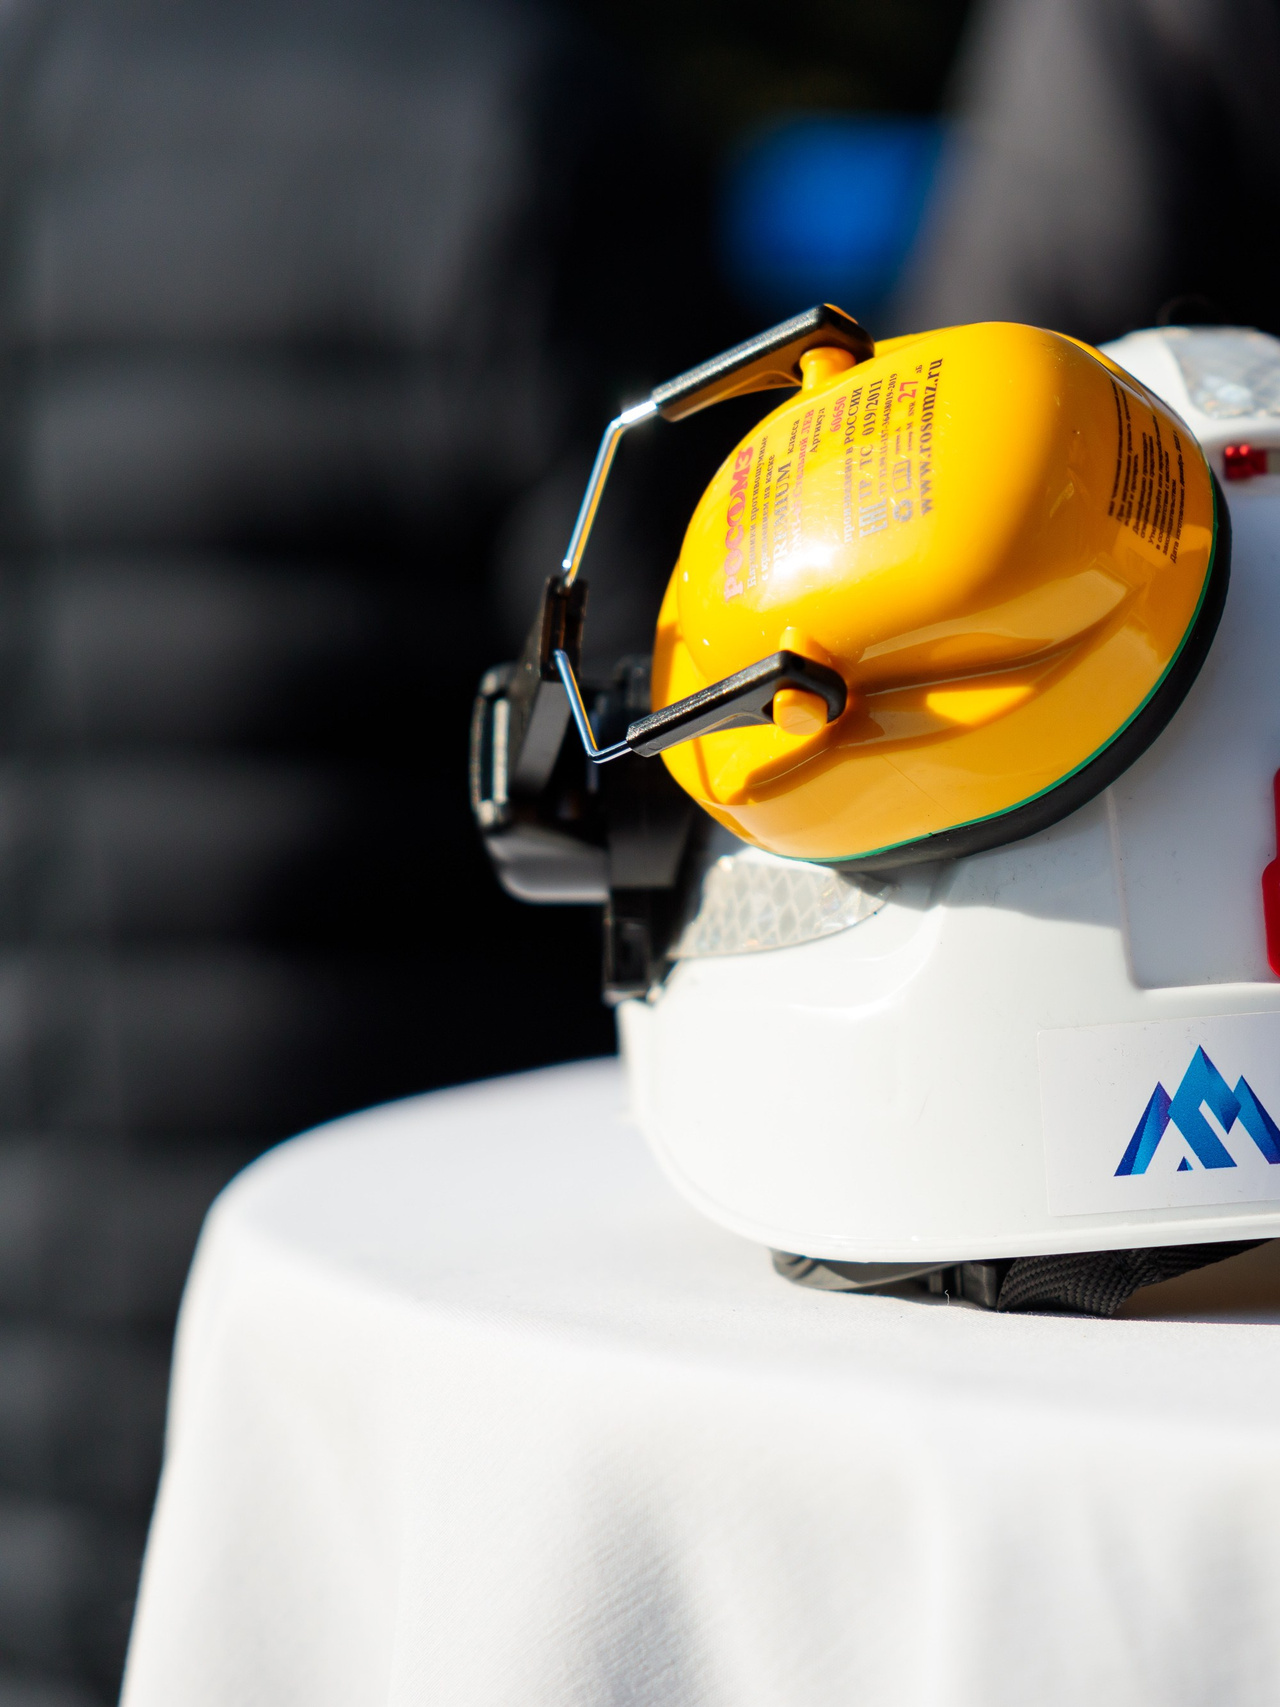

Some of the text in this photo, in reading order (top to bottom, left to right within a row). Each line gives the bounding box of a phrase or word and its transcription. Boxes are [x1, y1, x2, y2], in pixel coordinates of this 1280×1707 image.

[862, 378, 883, 436] 019/2011
[897, 380, 918, 403] 27
[809, 406, 825, 454] Артикул
[830, 395, 847, 432] 60650
[786, 418, 800, 454] класса
[793, 436, 808, 498] Стальной
[802, 408, 814, 434] ЛЕВ
[859, 444, 874, 470] ТС
[920, 357, 943, 515] www.rosomz.ru
[765, 454, 775, 482] каске
[844, 385, 863, 544] произведено в РОССИИ
[746, 435, 768, 588] Наушники противошумные
[763, 486, 770, 498] на
[725, 445, 754, 602] РОСОМЗ
[1169, 541, 1179, 563] Дата
